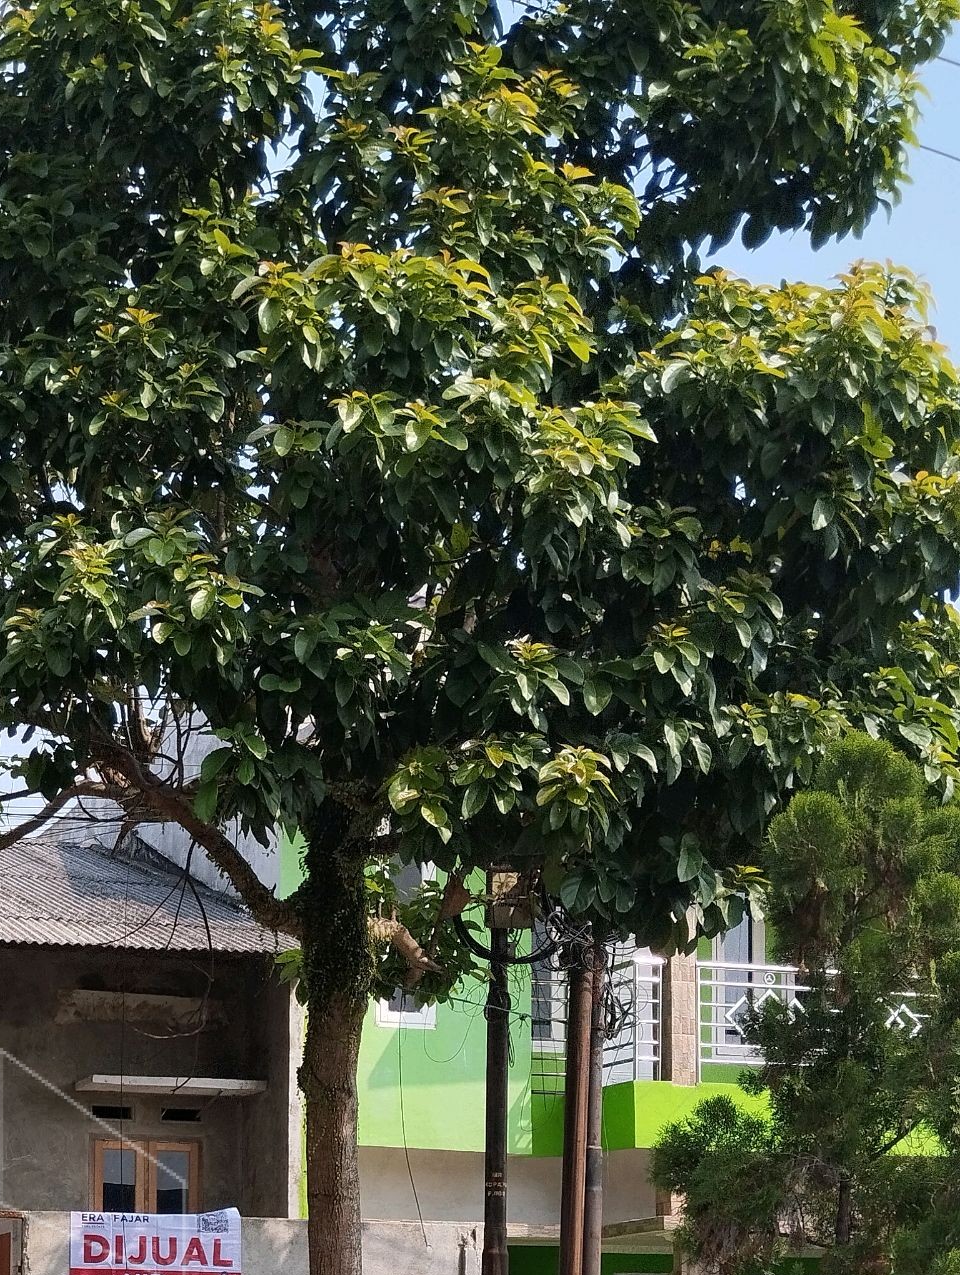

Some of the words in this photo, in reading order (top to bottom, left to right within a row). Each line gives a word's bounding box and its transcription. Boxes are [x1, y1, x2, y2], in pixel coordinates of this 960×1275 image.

[81, 1213, 104, 1222] ERA
[113, 1214, 149, 1223] FAJAR
[82, 1234, 233, 1267] DIJUAL
